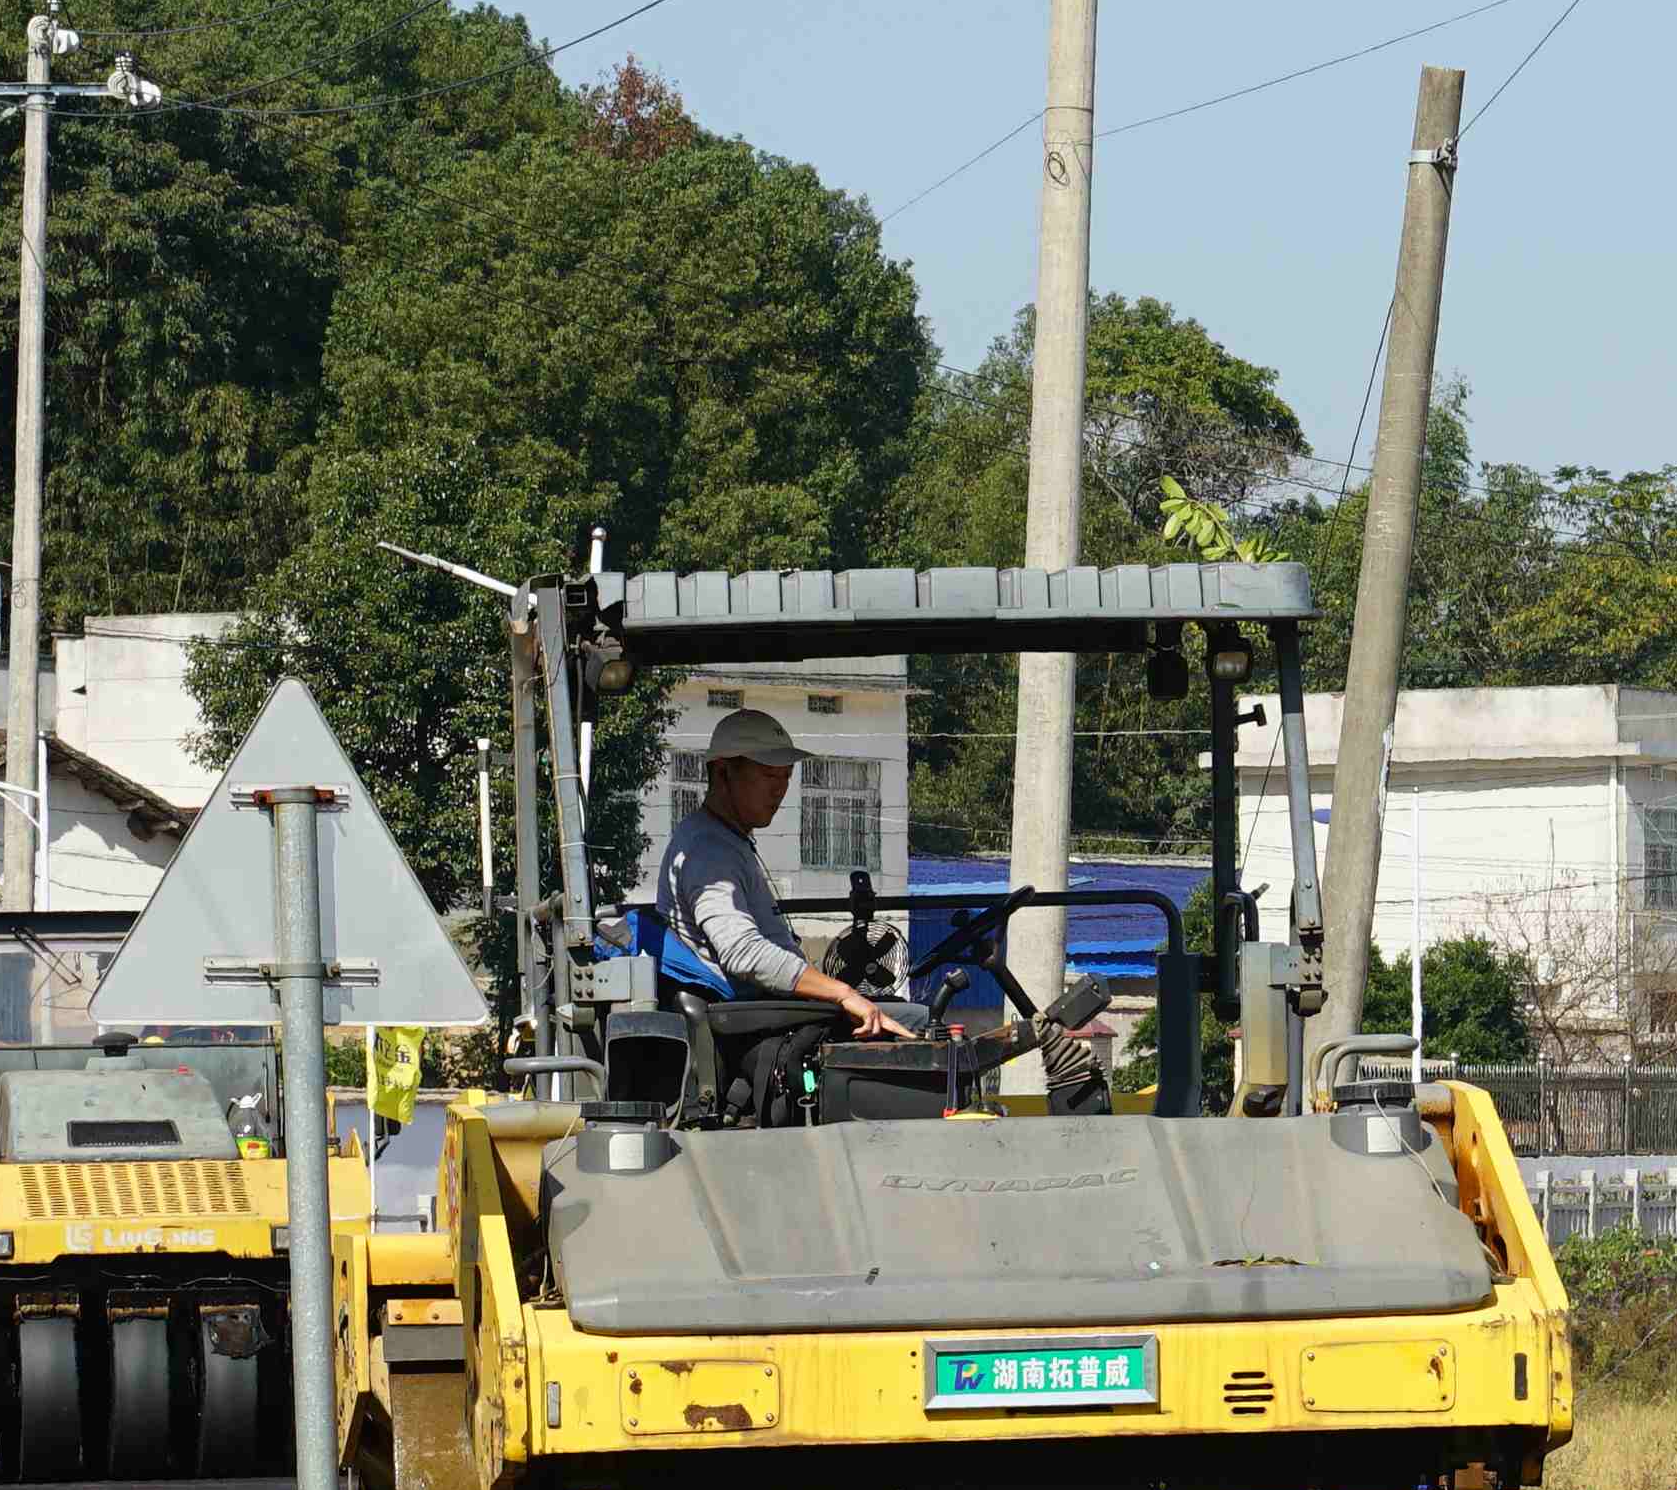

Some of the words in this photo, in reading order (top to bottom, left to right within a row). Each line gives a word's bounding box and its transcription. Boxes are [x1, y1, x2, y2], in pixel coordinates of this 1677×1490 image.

[879, 1167, 1140, 1193] DYNAPAC
[103, 1228, 217, 1246] LIUGNG
[993, 1354, 1130, 1390] 湖南拓普威
